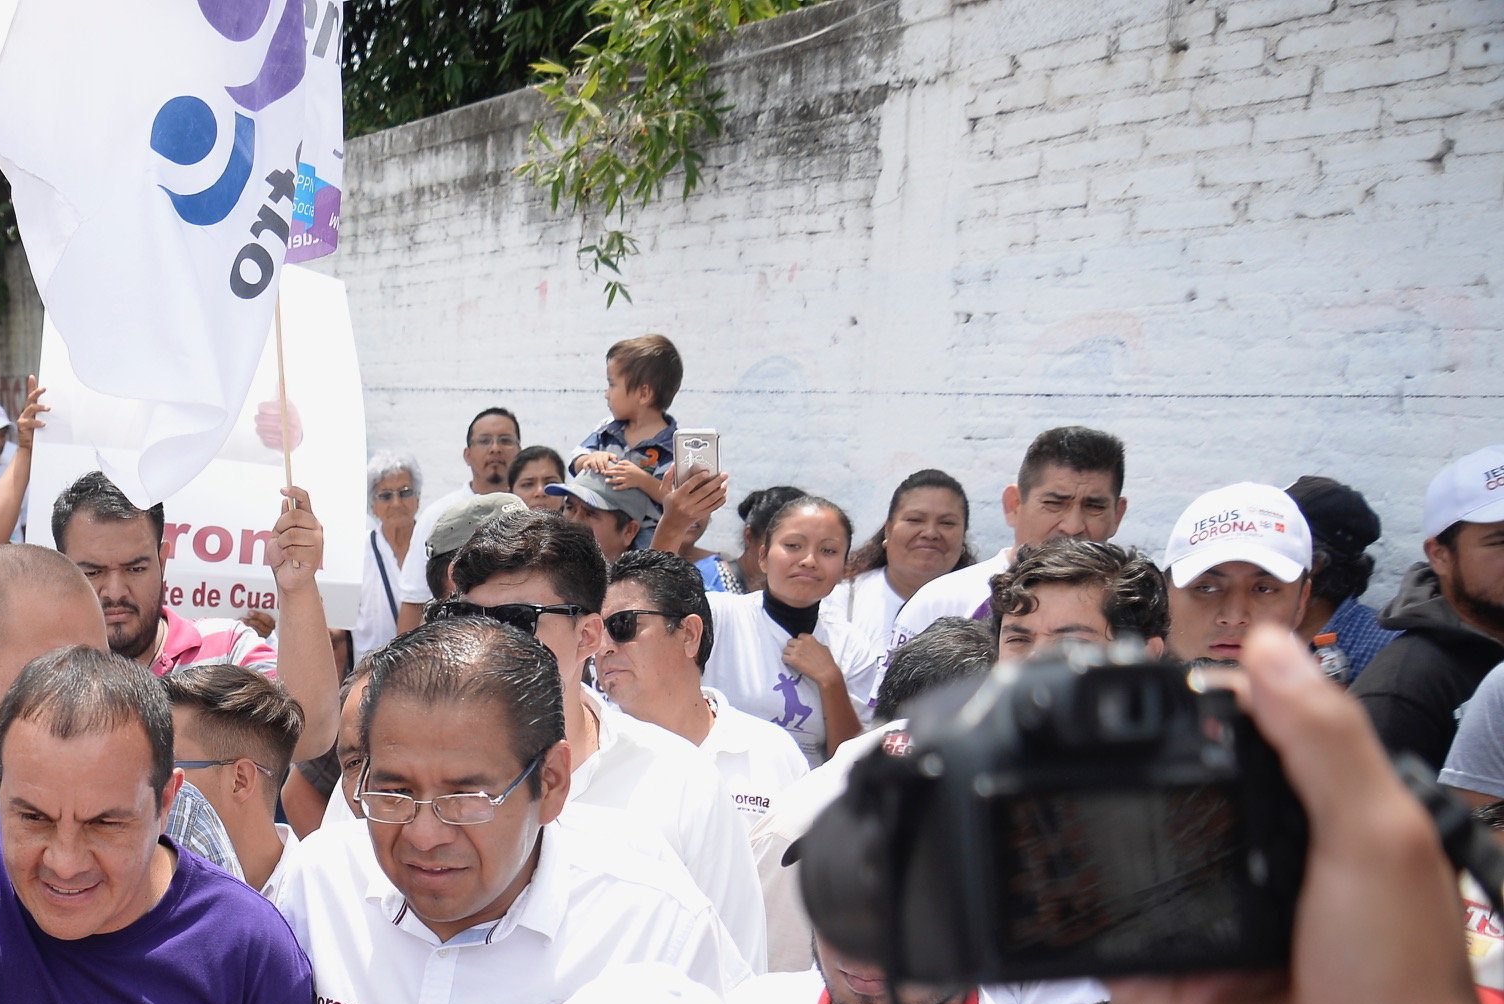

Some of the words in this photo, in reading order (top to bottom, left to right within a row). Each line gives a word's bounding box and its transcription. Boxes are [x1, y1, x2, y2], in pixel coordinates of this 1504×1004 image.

[1189, 520, 1258, 546] CORONA
[1193, 508, 1240, 534] JESÚS
[192, 582, 222, 608] de
[731, 793, 771, 809] orena
